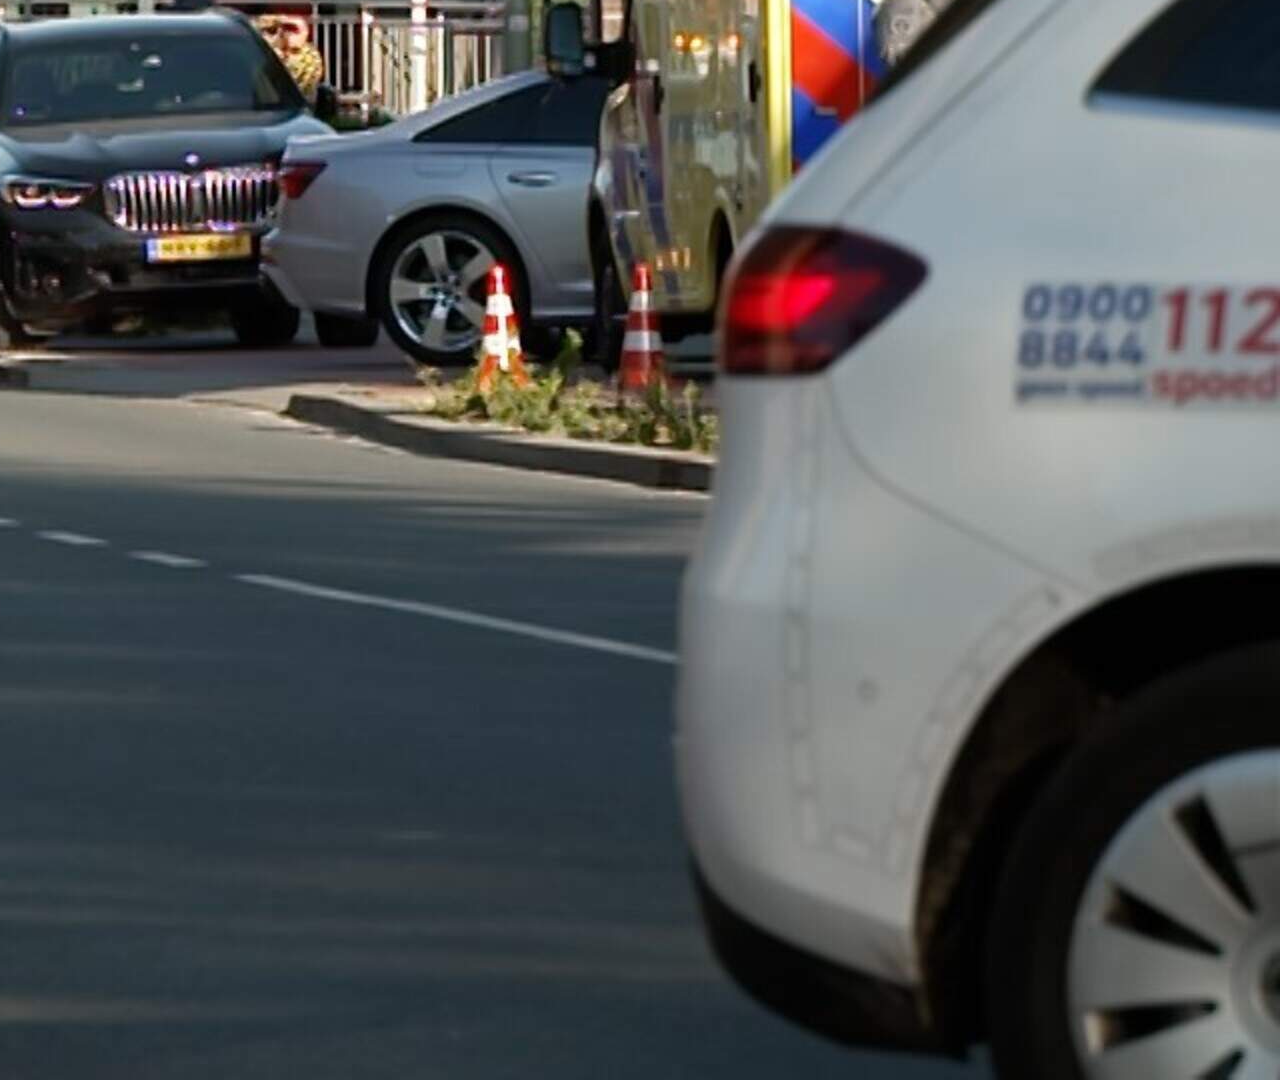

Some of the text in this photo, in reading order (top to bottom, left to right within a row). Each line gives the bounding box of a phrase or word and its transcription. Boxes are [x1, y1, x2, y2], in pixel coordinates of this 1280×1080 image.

[1023, 283, 1152, 323] 0900
[1162, 286, 1280, 355] 112
[1017, 328, 1144, 369] 8844
